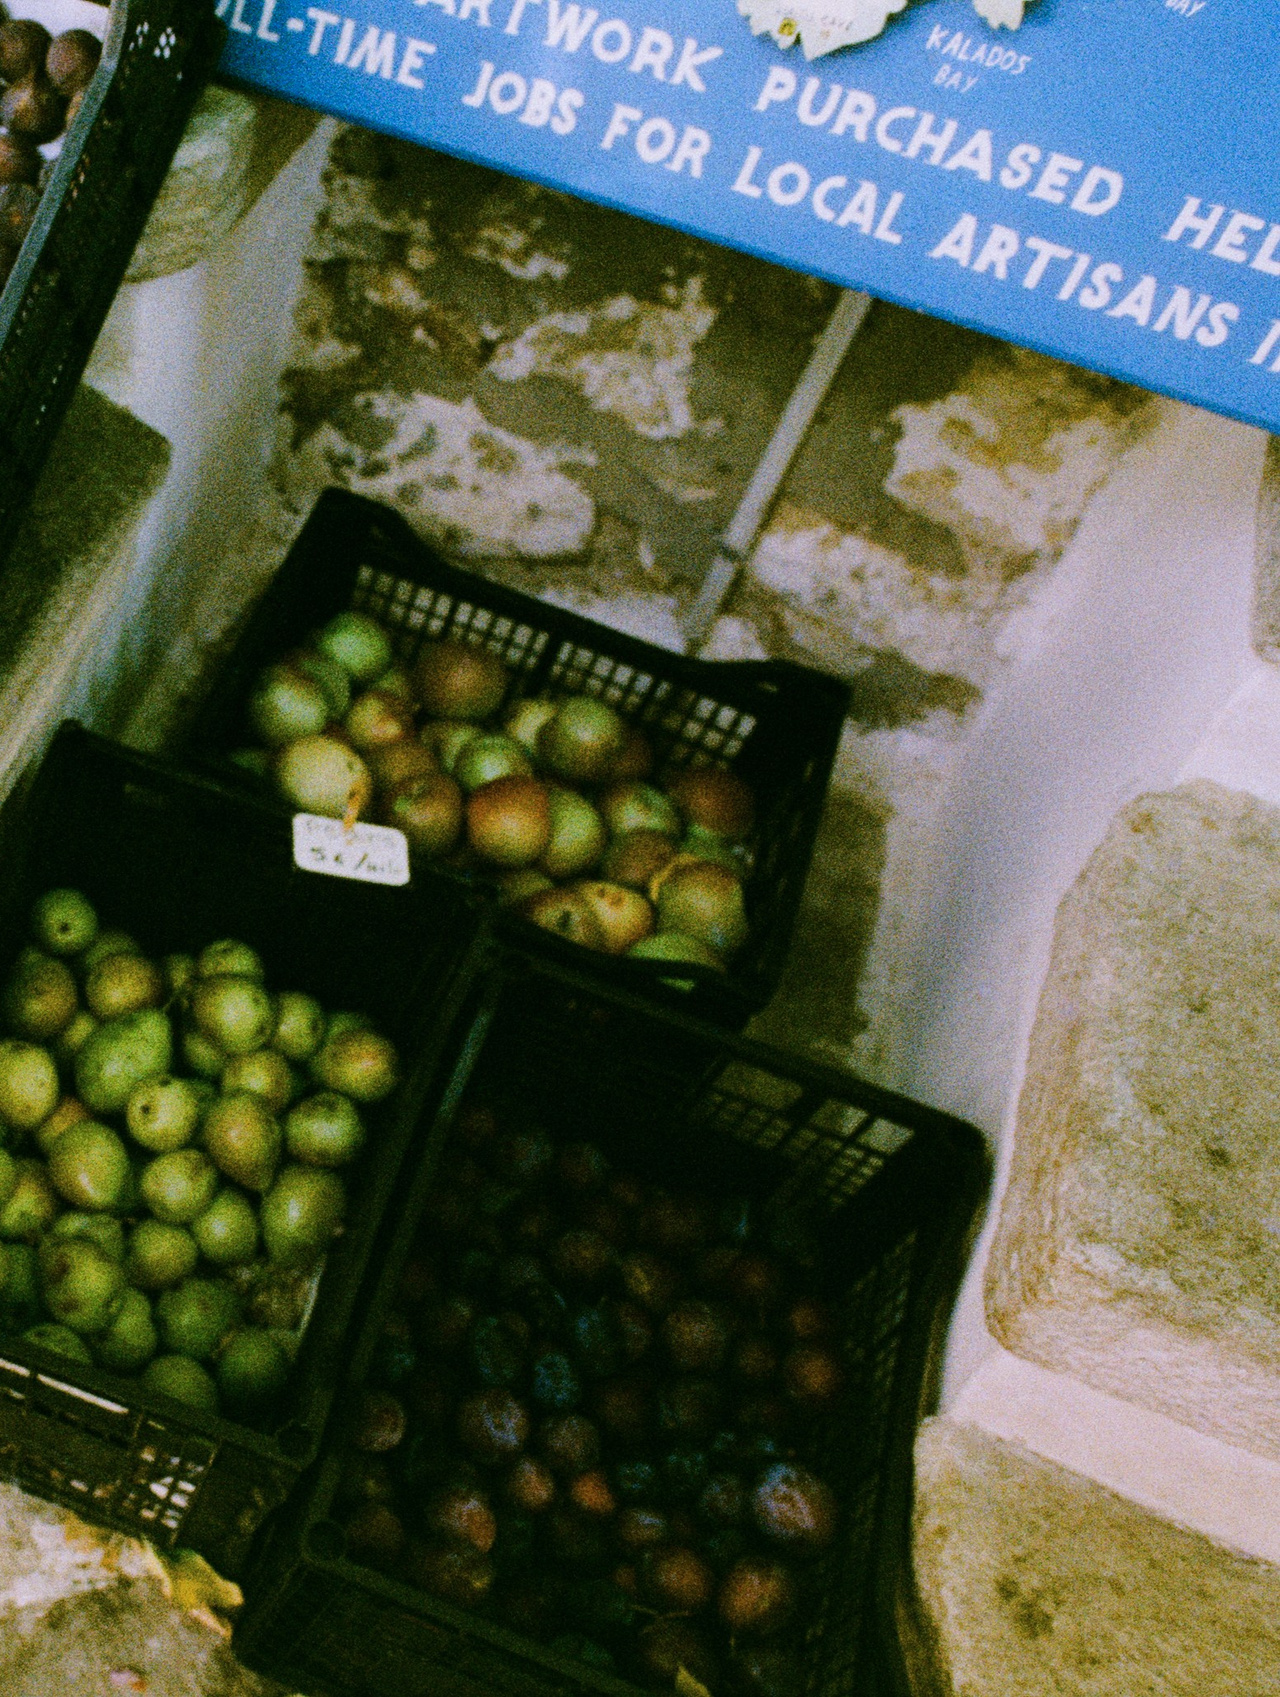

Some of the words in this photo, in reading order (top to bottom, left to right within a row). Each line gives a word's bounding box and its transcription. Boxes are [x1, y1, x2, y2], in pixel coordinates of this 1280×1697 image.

[412, 0, 722, 92] RTWORK
[754, 66, 1122, 216] PURCHASED
[925, 23, 1032, 75] KALADOS
[933, 63, 979, 93] BAY
[215, 0, 437, 89] LL-TIME
[461, 62, 585, 135] JOBS
[600, 104, 712, 179] FOR
[731, 146, 904, 245] LOCAL
[929, 213, 1240, 348] ARTISANS
